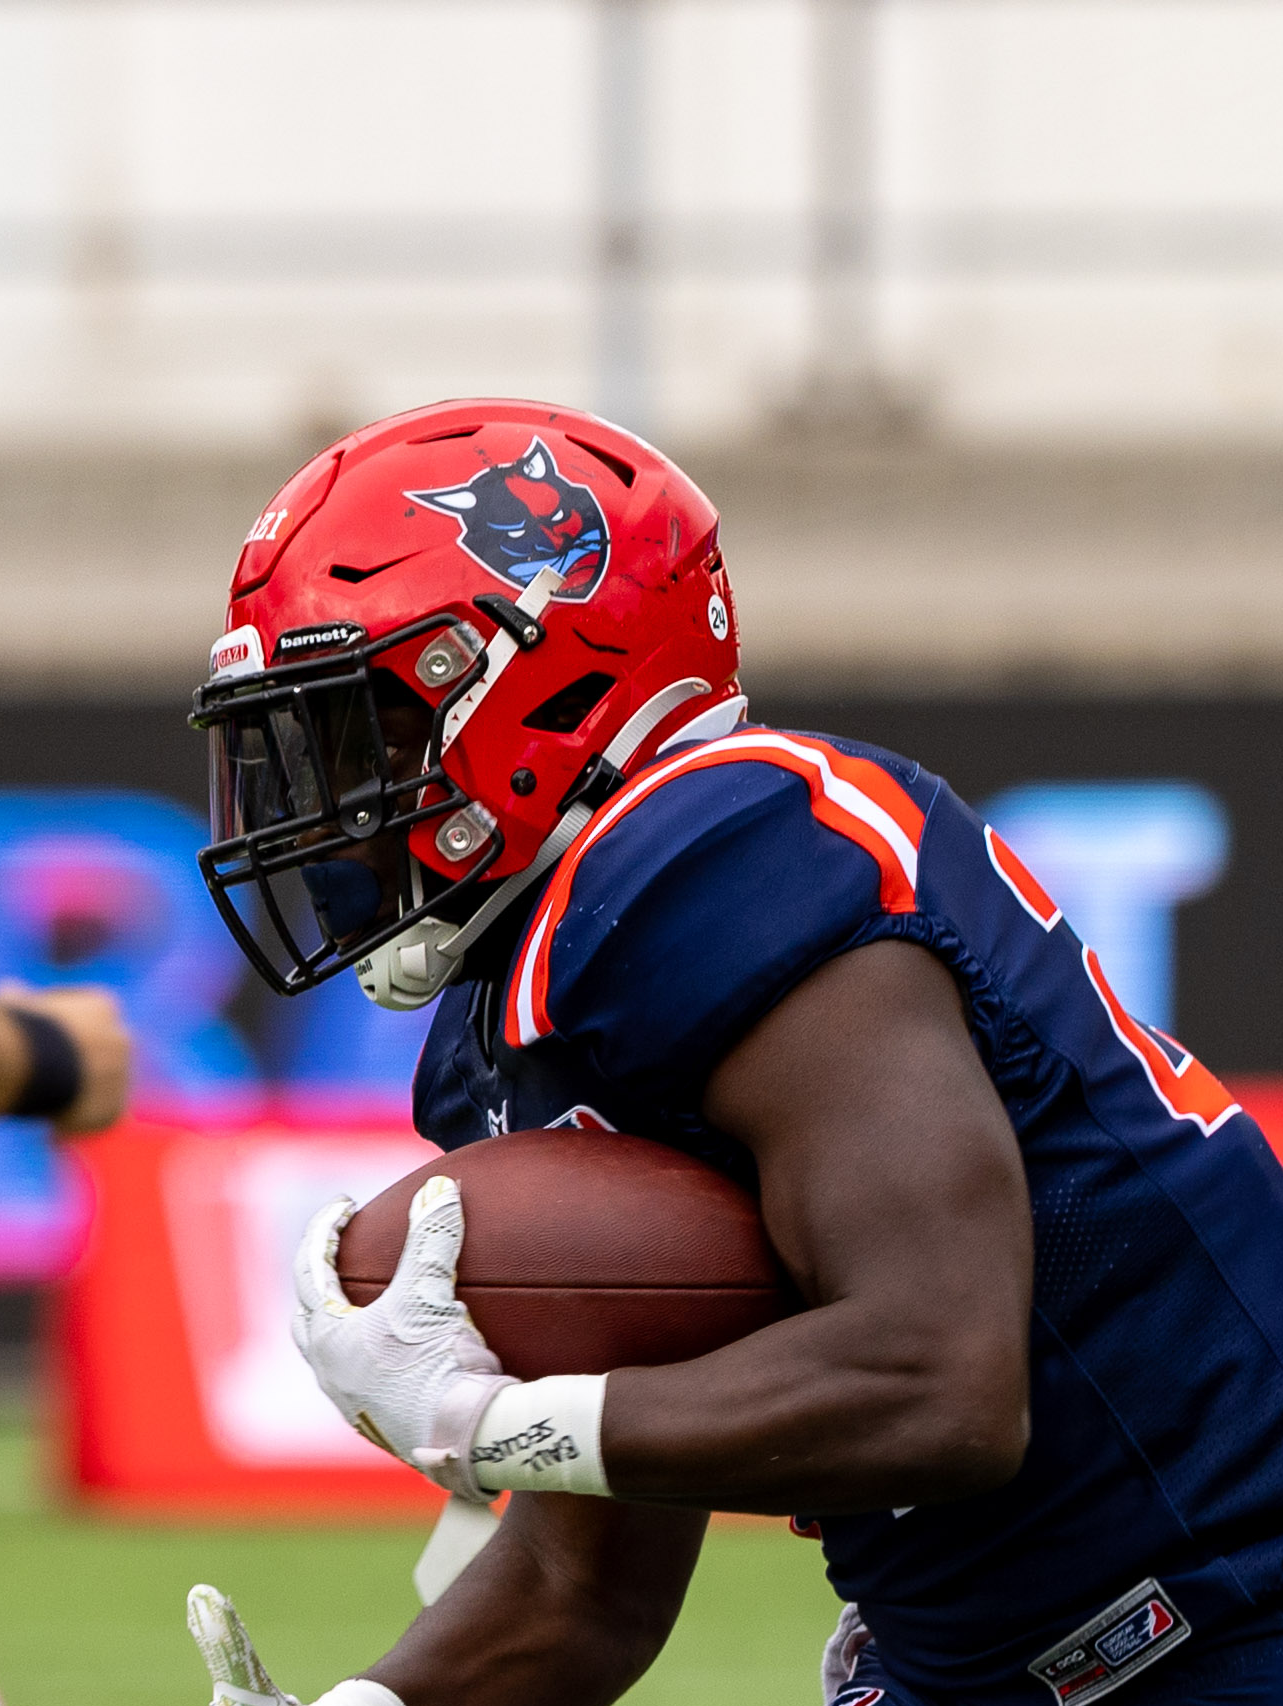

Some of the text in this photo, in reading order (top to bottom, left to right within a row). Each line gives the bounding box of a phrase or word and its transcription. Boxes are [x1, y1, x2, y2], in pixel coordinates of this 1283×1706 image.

[243, 508, 288, 545] AZI
[711, 606, 726, 630] 24
[280, 628, 348, 649] barnett
[218, 643, 246, 668] GAZI
